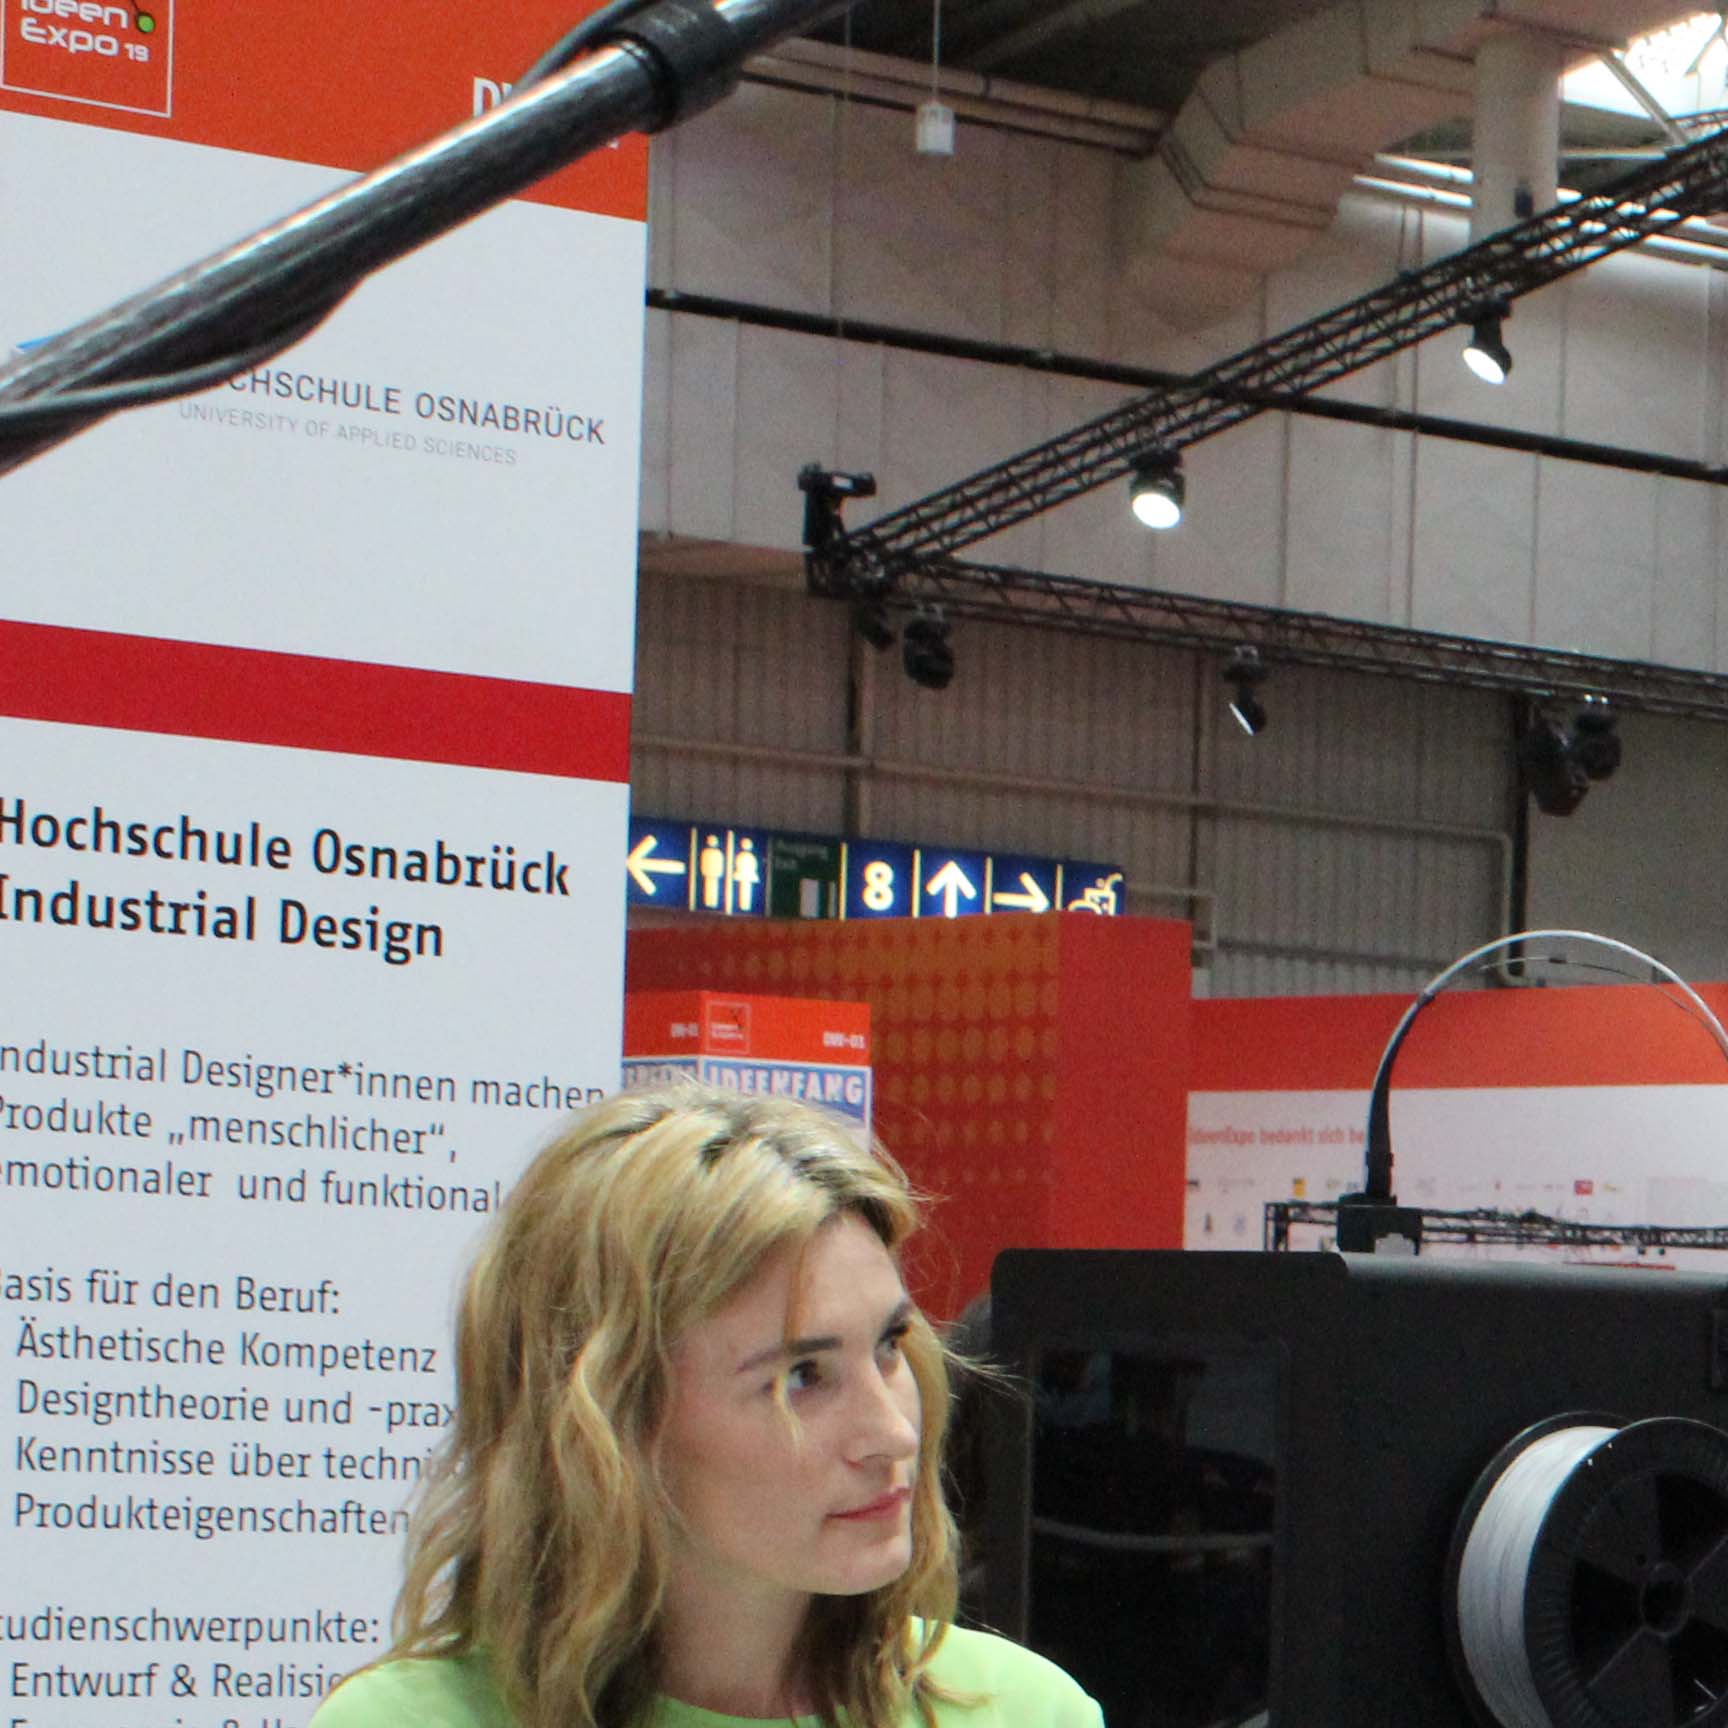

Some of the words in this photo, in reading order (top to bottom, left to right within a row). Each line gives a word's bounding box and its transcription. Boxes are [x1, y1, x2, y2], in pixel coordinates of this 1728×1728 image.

[20, 17, 120, 57] Expo
[124, 42, 151, 63] 19
[178, 401, 297, 434] UNIVERSITY
[304, 420, 330, 439] OF
[336, 424, 418, 452] APPLIED
[423, 437, 518, 466] SCIENCES
[228, 368, 401, 415] CHSCHULE
[414, 391, 607, 446] OSNABRÜCK
[0, 797, 292, 871] Hochschule
[312, 828, 571, 898] Osnabrück
[861, 860, 895, 912] 8
[0, 873, 256, 943] Industrial
[279, 898, 445, 966] Design
[1, 1039, 167, 1083] ndustrial
[472, 1075, 605, 1111] machen
[1348, 1125, 1368, 1146] be
[0, 1156, 212, 1199] motionaler
[237, 1168, 305, 1203] und
[321, 1170, 501, 1214] funktional
[0, 1267, 73, 1303] asis
[86, 1268, 140, 1307] für
[151, 1270, 220, 1312] den
[235, 1273, 341, 1316] Beruf:
[16, 1316, 226, 1366] Ästhetische
[240, 1330, 437, 1379] Kompetenz
[16, 1378, 270, 1425] Designtheorie
[284, 1386, 352, 1426] und
[367, 1400, 456, 1433] -prax
[15, 1437, 214, 1478] Kenntnisse
[229, 1439, 311, 1481] über
[14, 1493, 410, 1541] Produkteigenschaften
[11, 1661, 157, 1698] Entwurf
[170, 1663, 197, 1698] &
